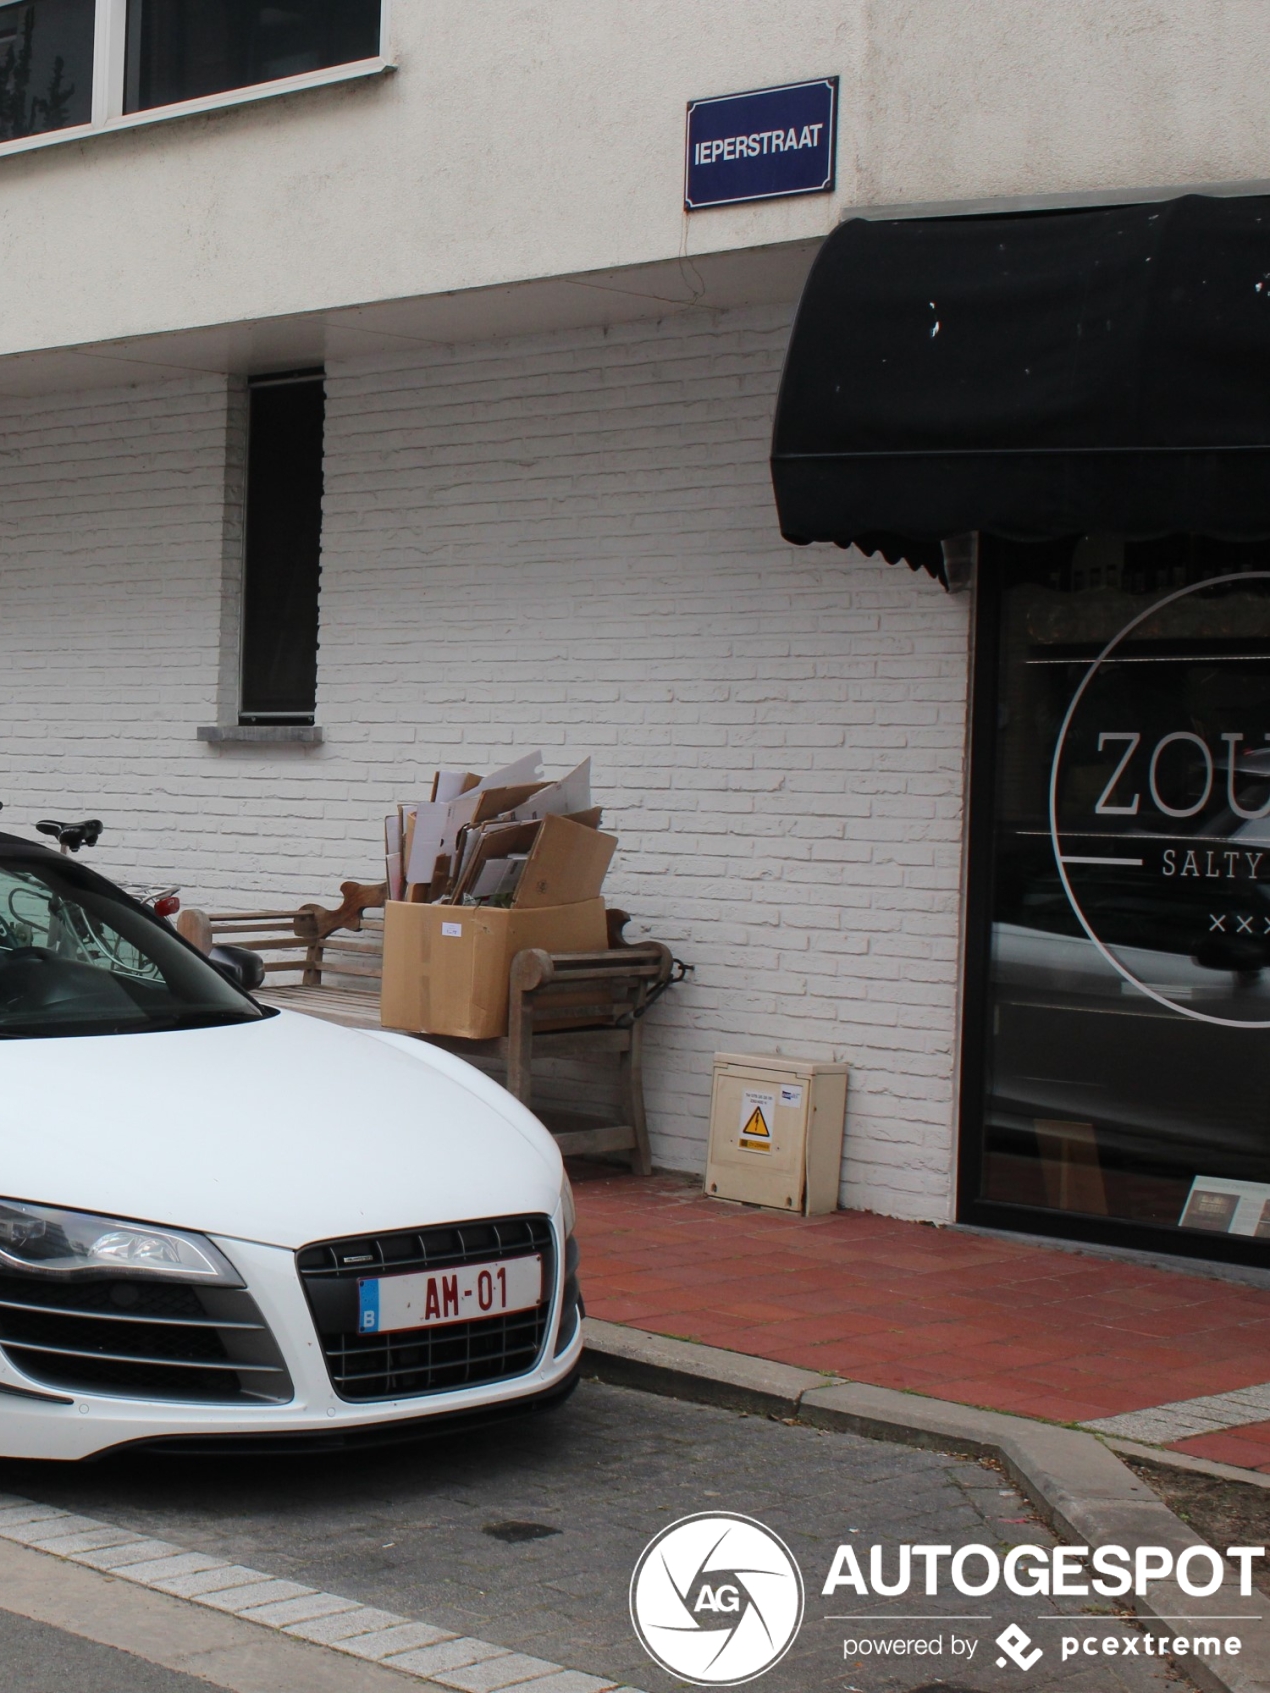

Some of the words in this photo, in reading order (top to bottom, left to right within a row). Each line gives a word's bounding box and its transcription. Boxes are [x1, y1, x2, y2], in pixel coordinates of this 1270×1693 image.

[694, 123, 823, 166] IEPERSTRAAT
[1162, 849, 1264, 879] SALTY
[425, 1267, 506, 1320] AM-01
[363, 1310, 375, 1328] B
